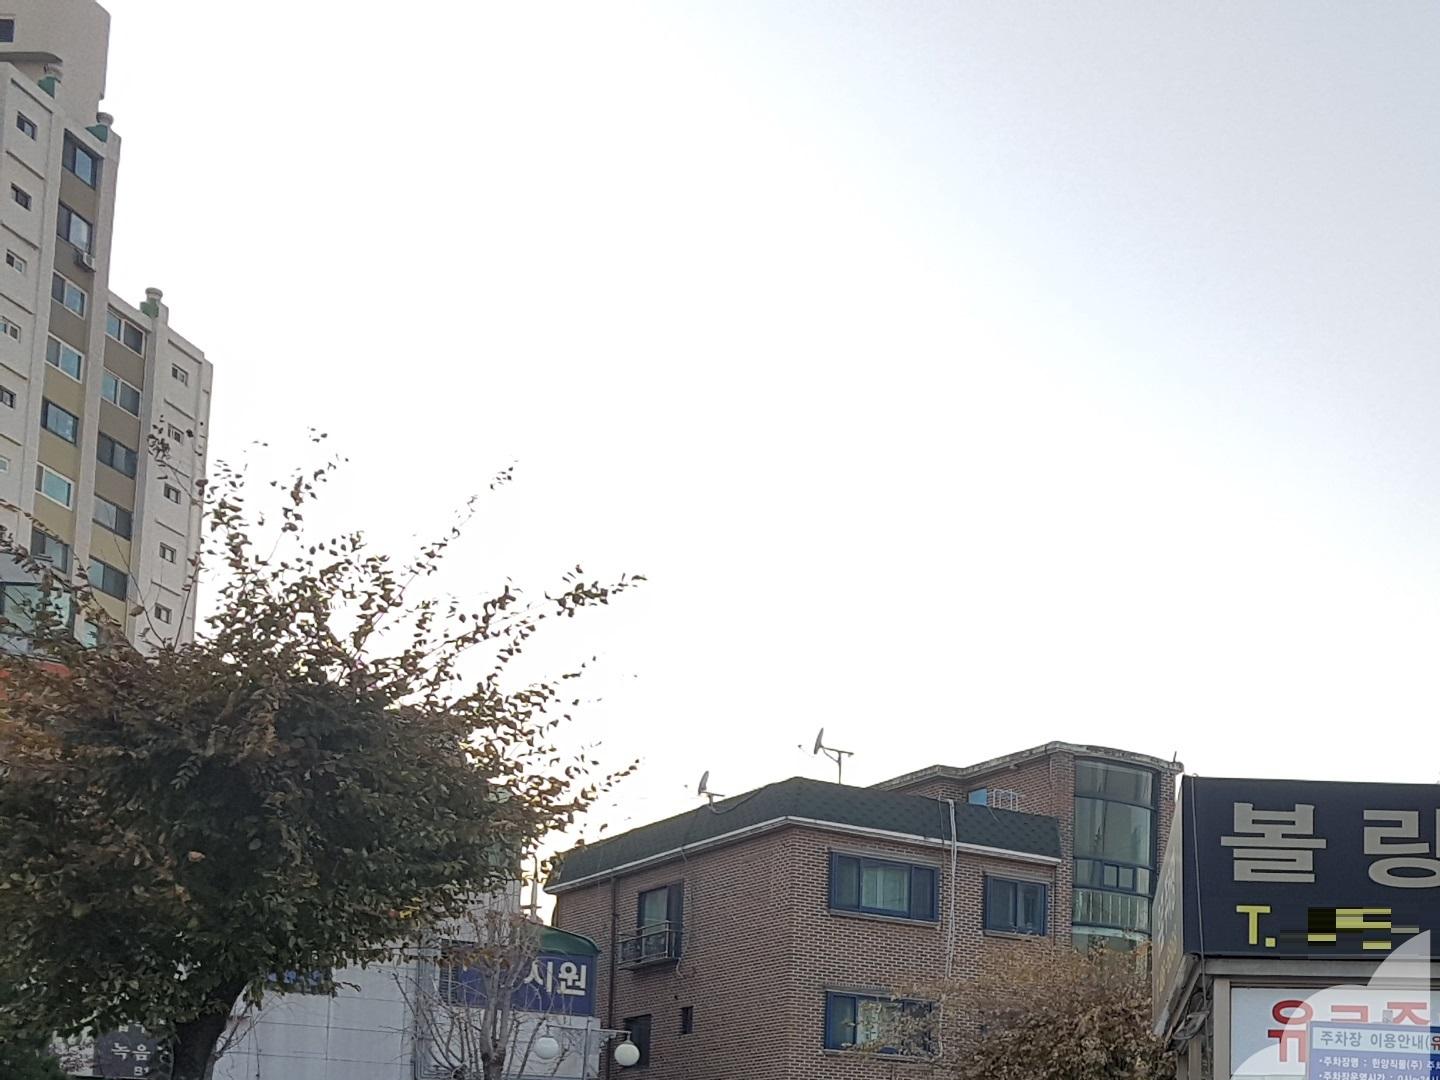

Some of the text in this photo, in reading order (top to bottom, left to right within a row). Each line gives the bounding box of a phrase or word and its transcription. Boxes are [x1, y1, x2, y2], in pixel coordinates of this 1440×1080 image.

[520, 961, 587, 996] 시원
[1320, 1031, 1363, 1047] 주차장
[111, 1042, 158, 1061] 녹음
